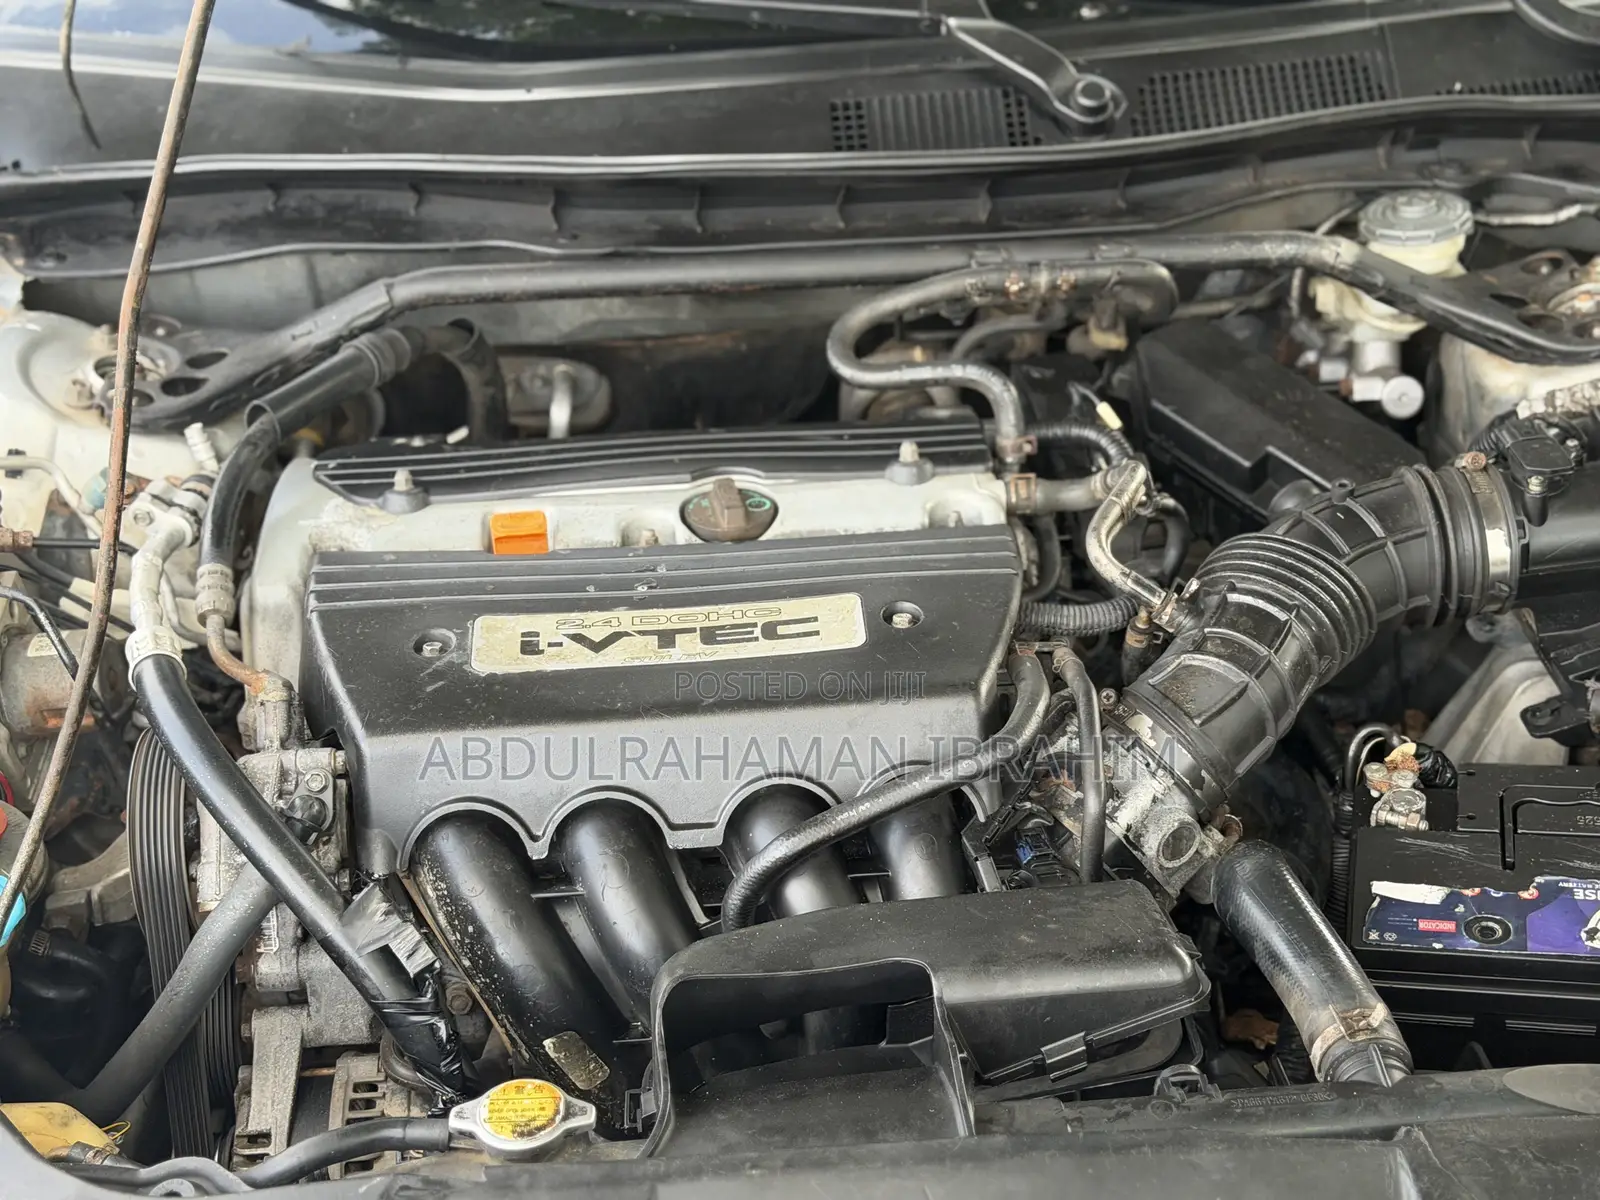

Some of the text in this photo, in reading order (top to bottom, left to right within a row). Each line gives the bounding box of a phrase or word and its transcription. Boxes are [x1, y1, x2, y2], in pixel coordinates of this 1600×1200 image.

[556, 607, 782, 630] 2.4 DOHC
[520, 616, 821, 656] i-VTEC
[1418, 921, 1456, 930] INDICATOR
